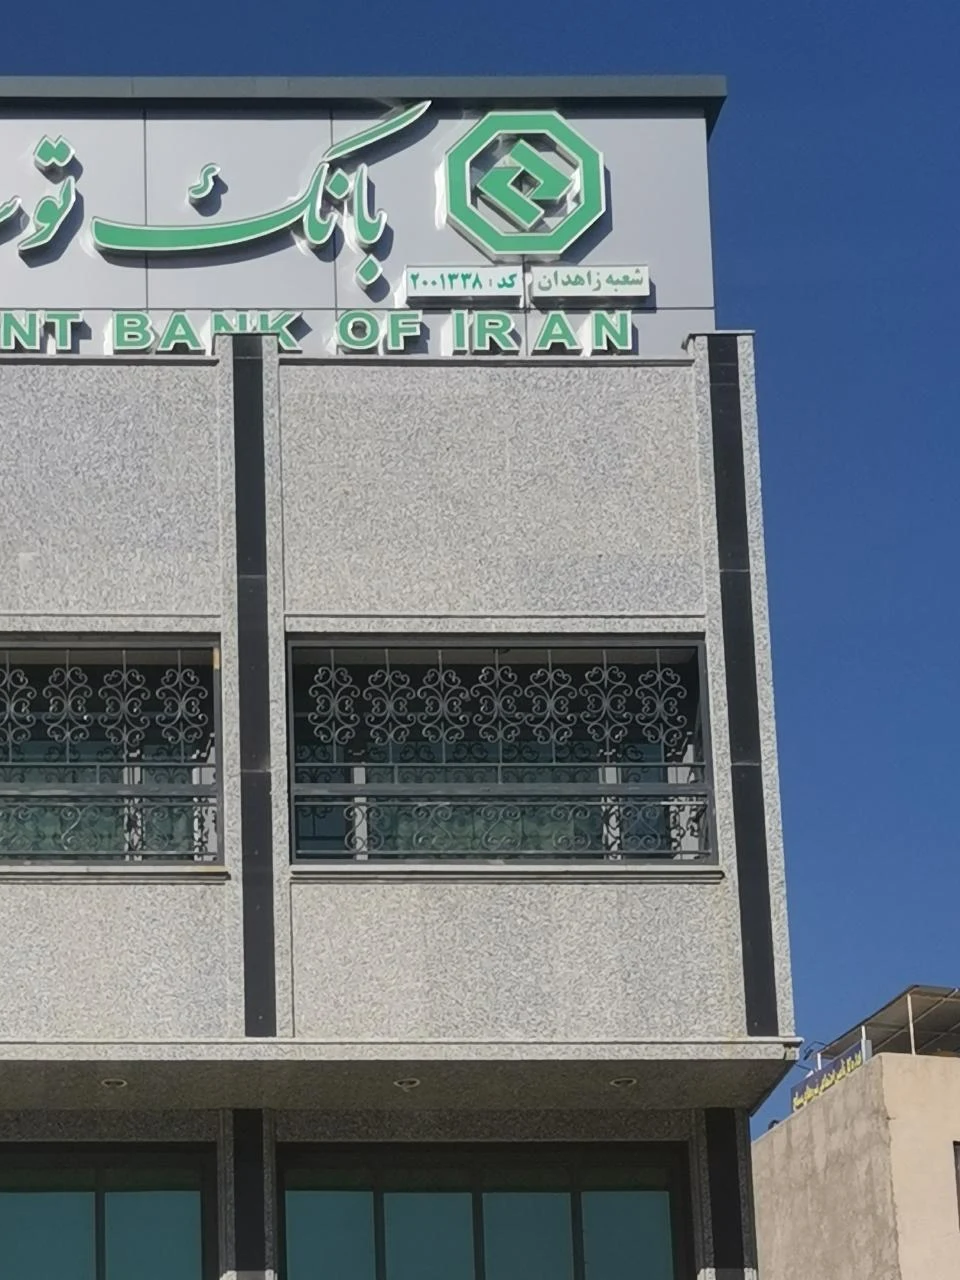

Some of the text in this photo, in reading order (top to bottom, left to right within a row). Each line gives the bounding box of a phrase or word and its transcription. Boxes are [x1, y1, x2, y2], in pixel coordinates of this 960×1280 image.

[91, 99, 432, 285] بانک
[409, 272, 483, 290] ۲۰۰۱۳۳۸
[537, 268, 645, 292] شعبه زاهدان
[112, 309, 304, 351] BANK
[338, 309, 423, 351] OF
[450, 309, 633, 351] IRAN
